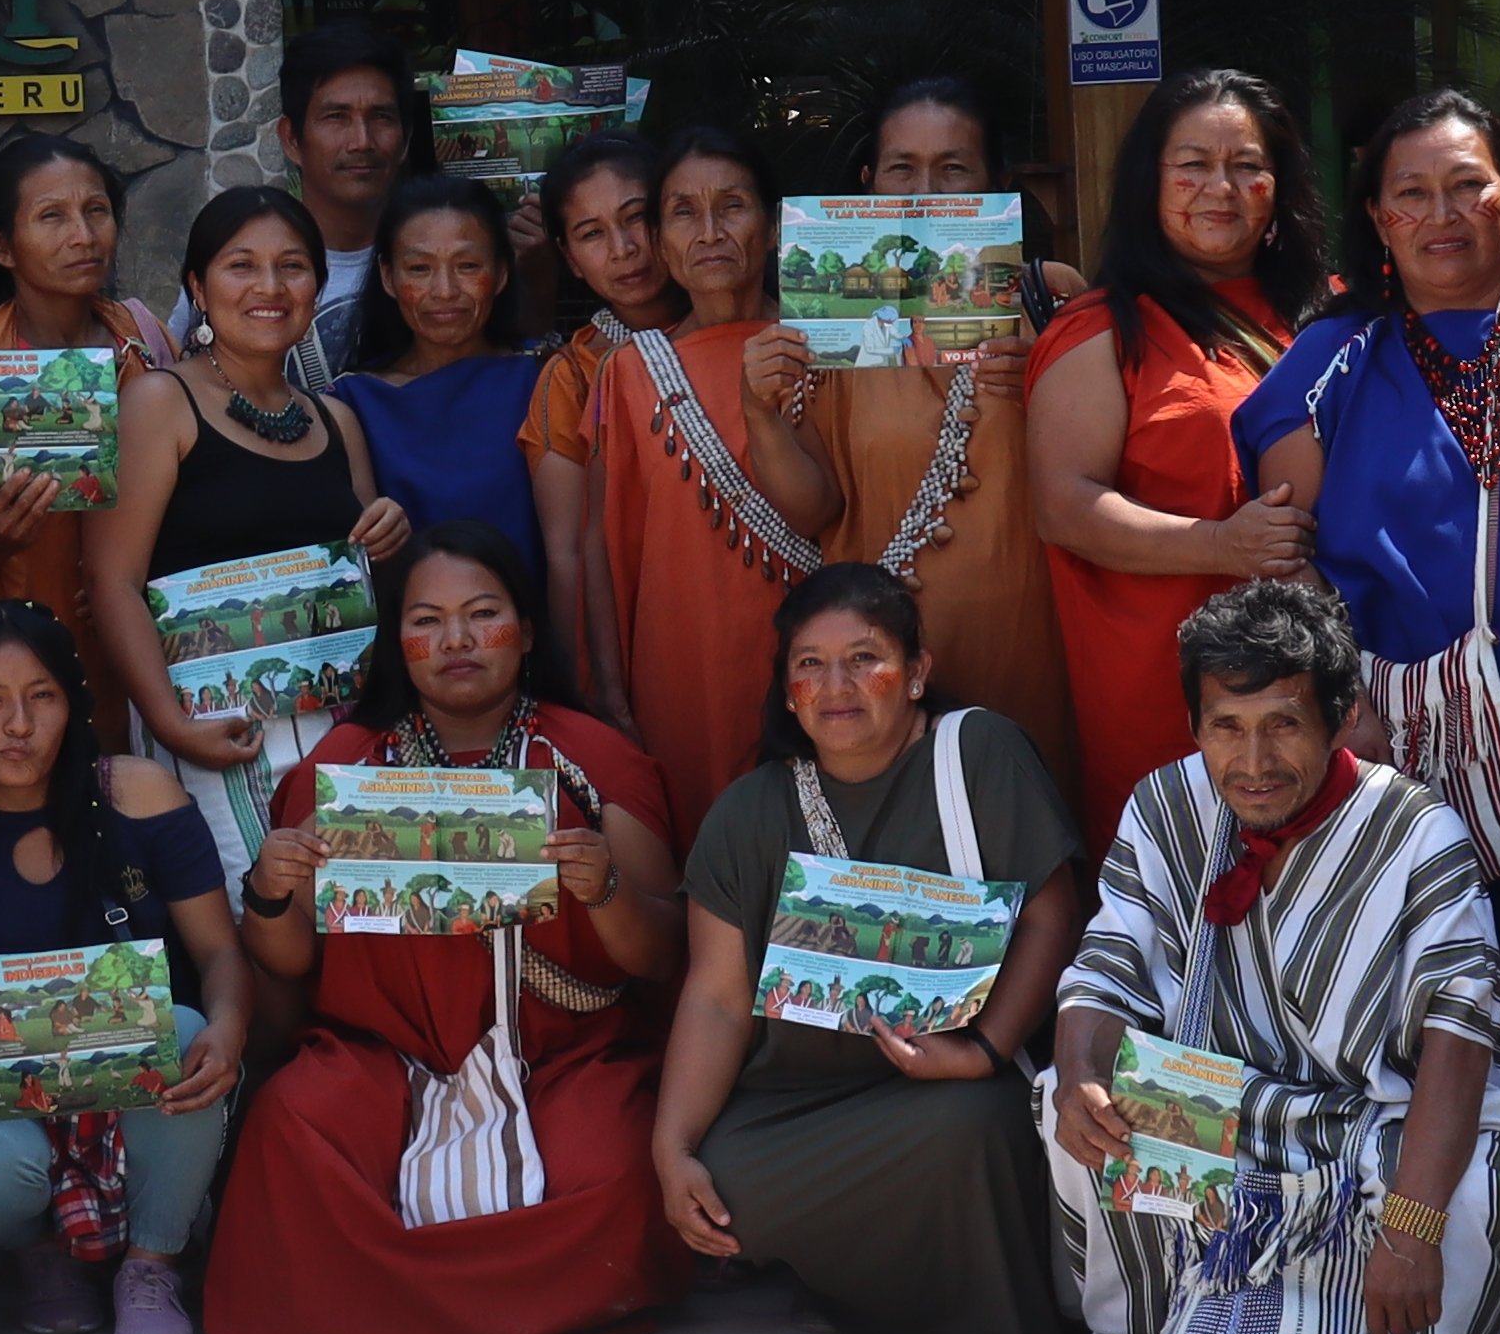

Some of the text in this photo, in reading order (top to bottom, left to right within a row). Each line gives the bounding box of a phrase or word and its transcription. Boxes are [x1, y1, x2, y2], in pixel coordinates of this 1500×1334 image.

[1089, 32, 1123, 42] CONFORT
[1073, 48, 1158, 61] USO OBLIGATORIO
[1081, 60, 1153, 73] DE MASCARILLA
[945, 352, 961, 361] YO
[963, 351, 976, 361] ME
[259, 568, 269, 579] Y
[271, 558, 329, 576] YANESHA
[438, 783, 447, 794] Y
[450, 784, 510, 795] YANESHA
[907, 883, 918, 895] Y
[921, 885, 980, 905] YANESHA
